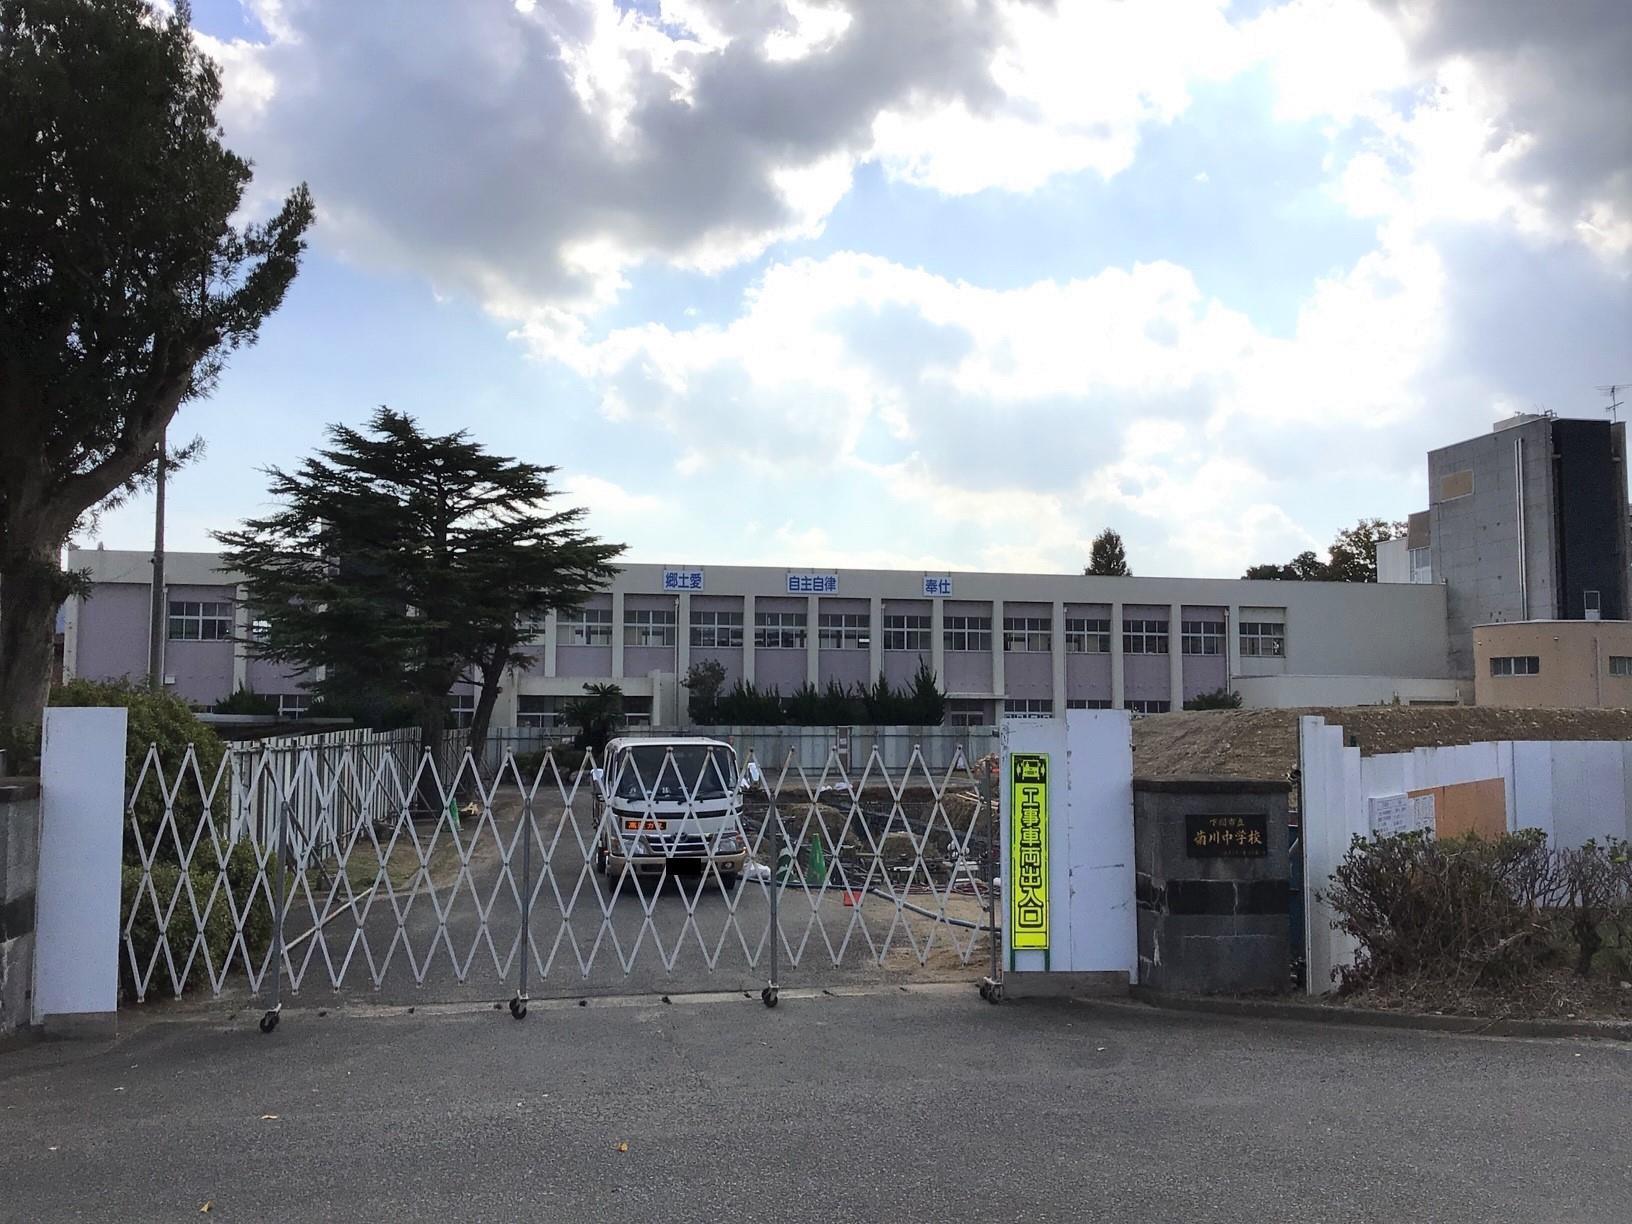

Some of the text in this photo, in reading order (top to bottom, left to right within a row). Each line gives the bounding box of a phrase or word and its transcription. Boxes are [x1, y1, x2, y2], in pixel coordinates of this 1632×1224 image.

[664, 572, 702, 590] 郷土愛
[788, 575, 837, 593] 自主自律
[925, 577, 951, 595] 奉仕
[1018, 786, 1044, 928] 工事車両出入口
